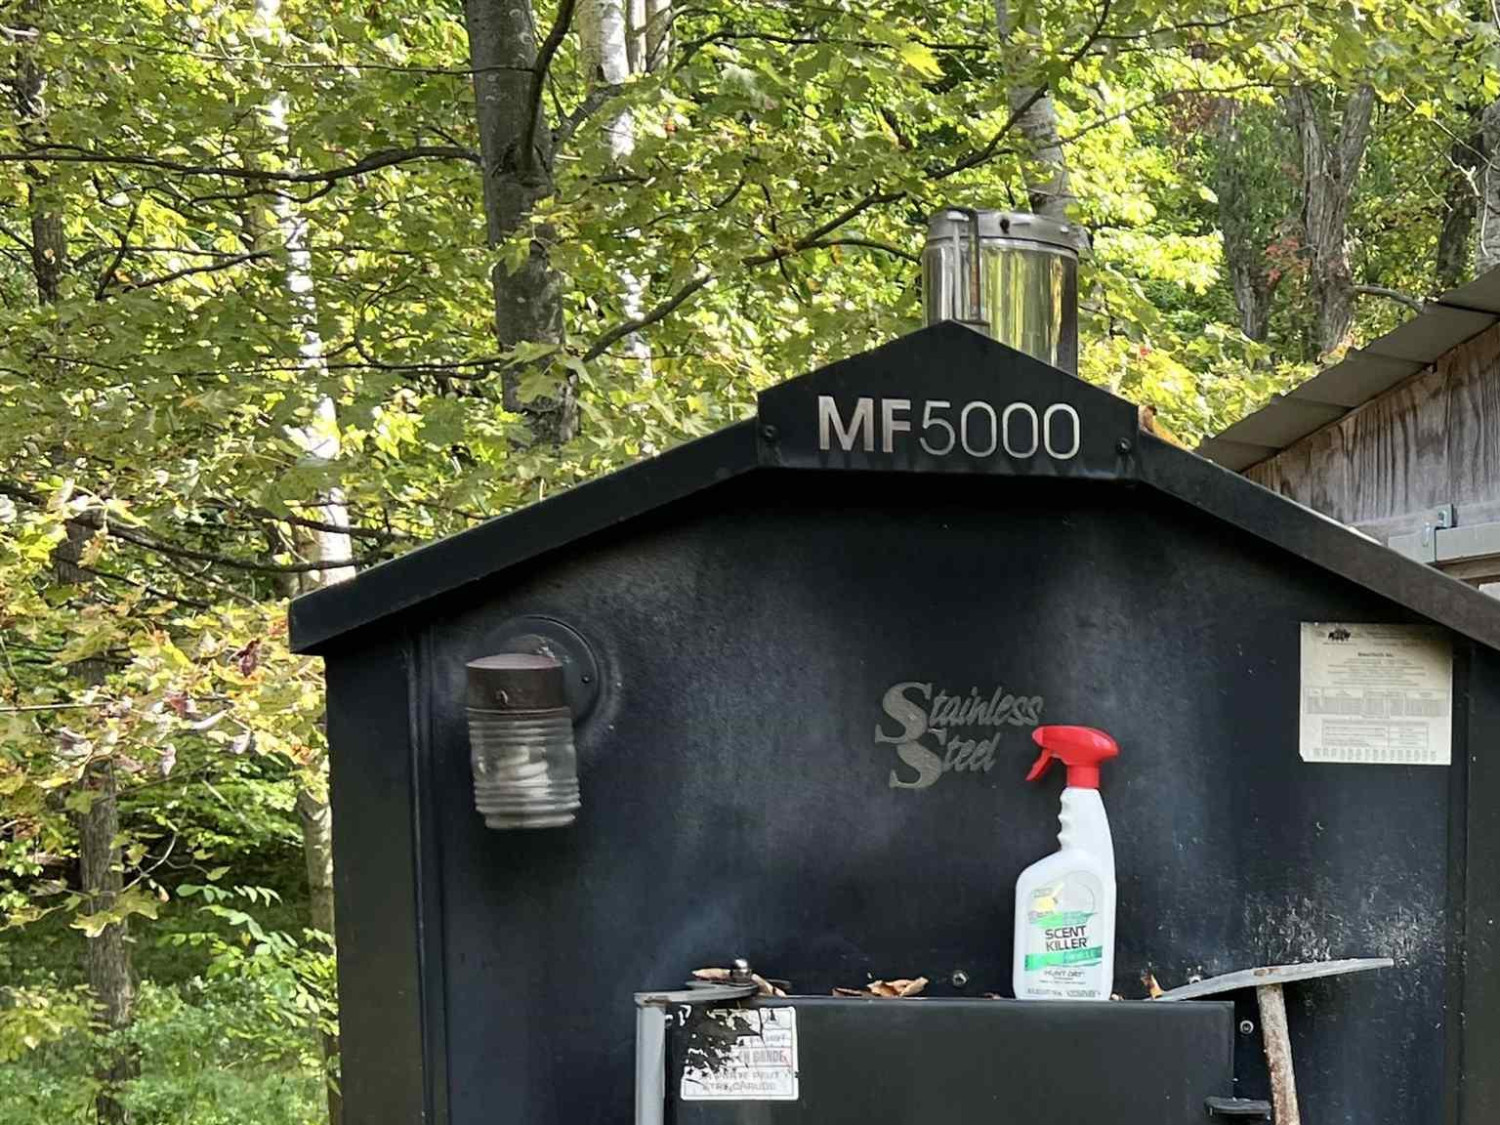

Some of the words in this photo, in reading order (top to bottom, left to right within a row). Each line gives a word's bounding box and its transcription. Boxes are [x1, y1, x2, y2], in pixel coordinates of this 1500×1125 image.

[818, 395, 1081, 460] MF5000
[874, 681, 1044, 744] Stainless
[889, 727, 1000, 789] Steel
[1045, 925, 1087, 940] SCENT
[1045, 937, 1087, 952] KILLER
